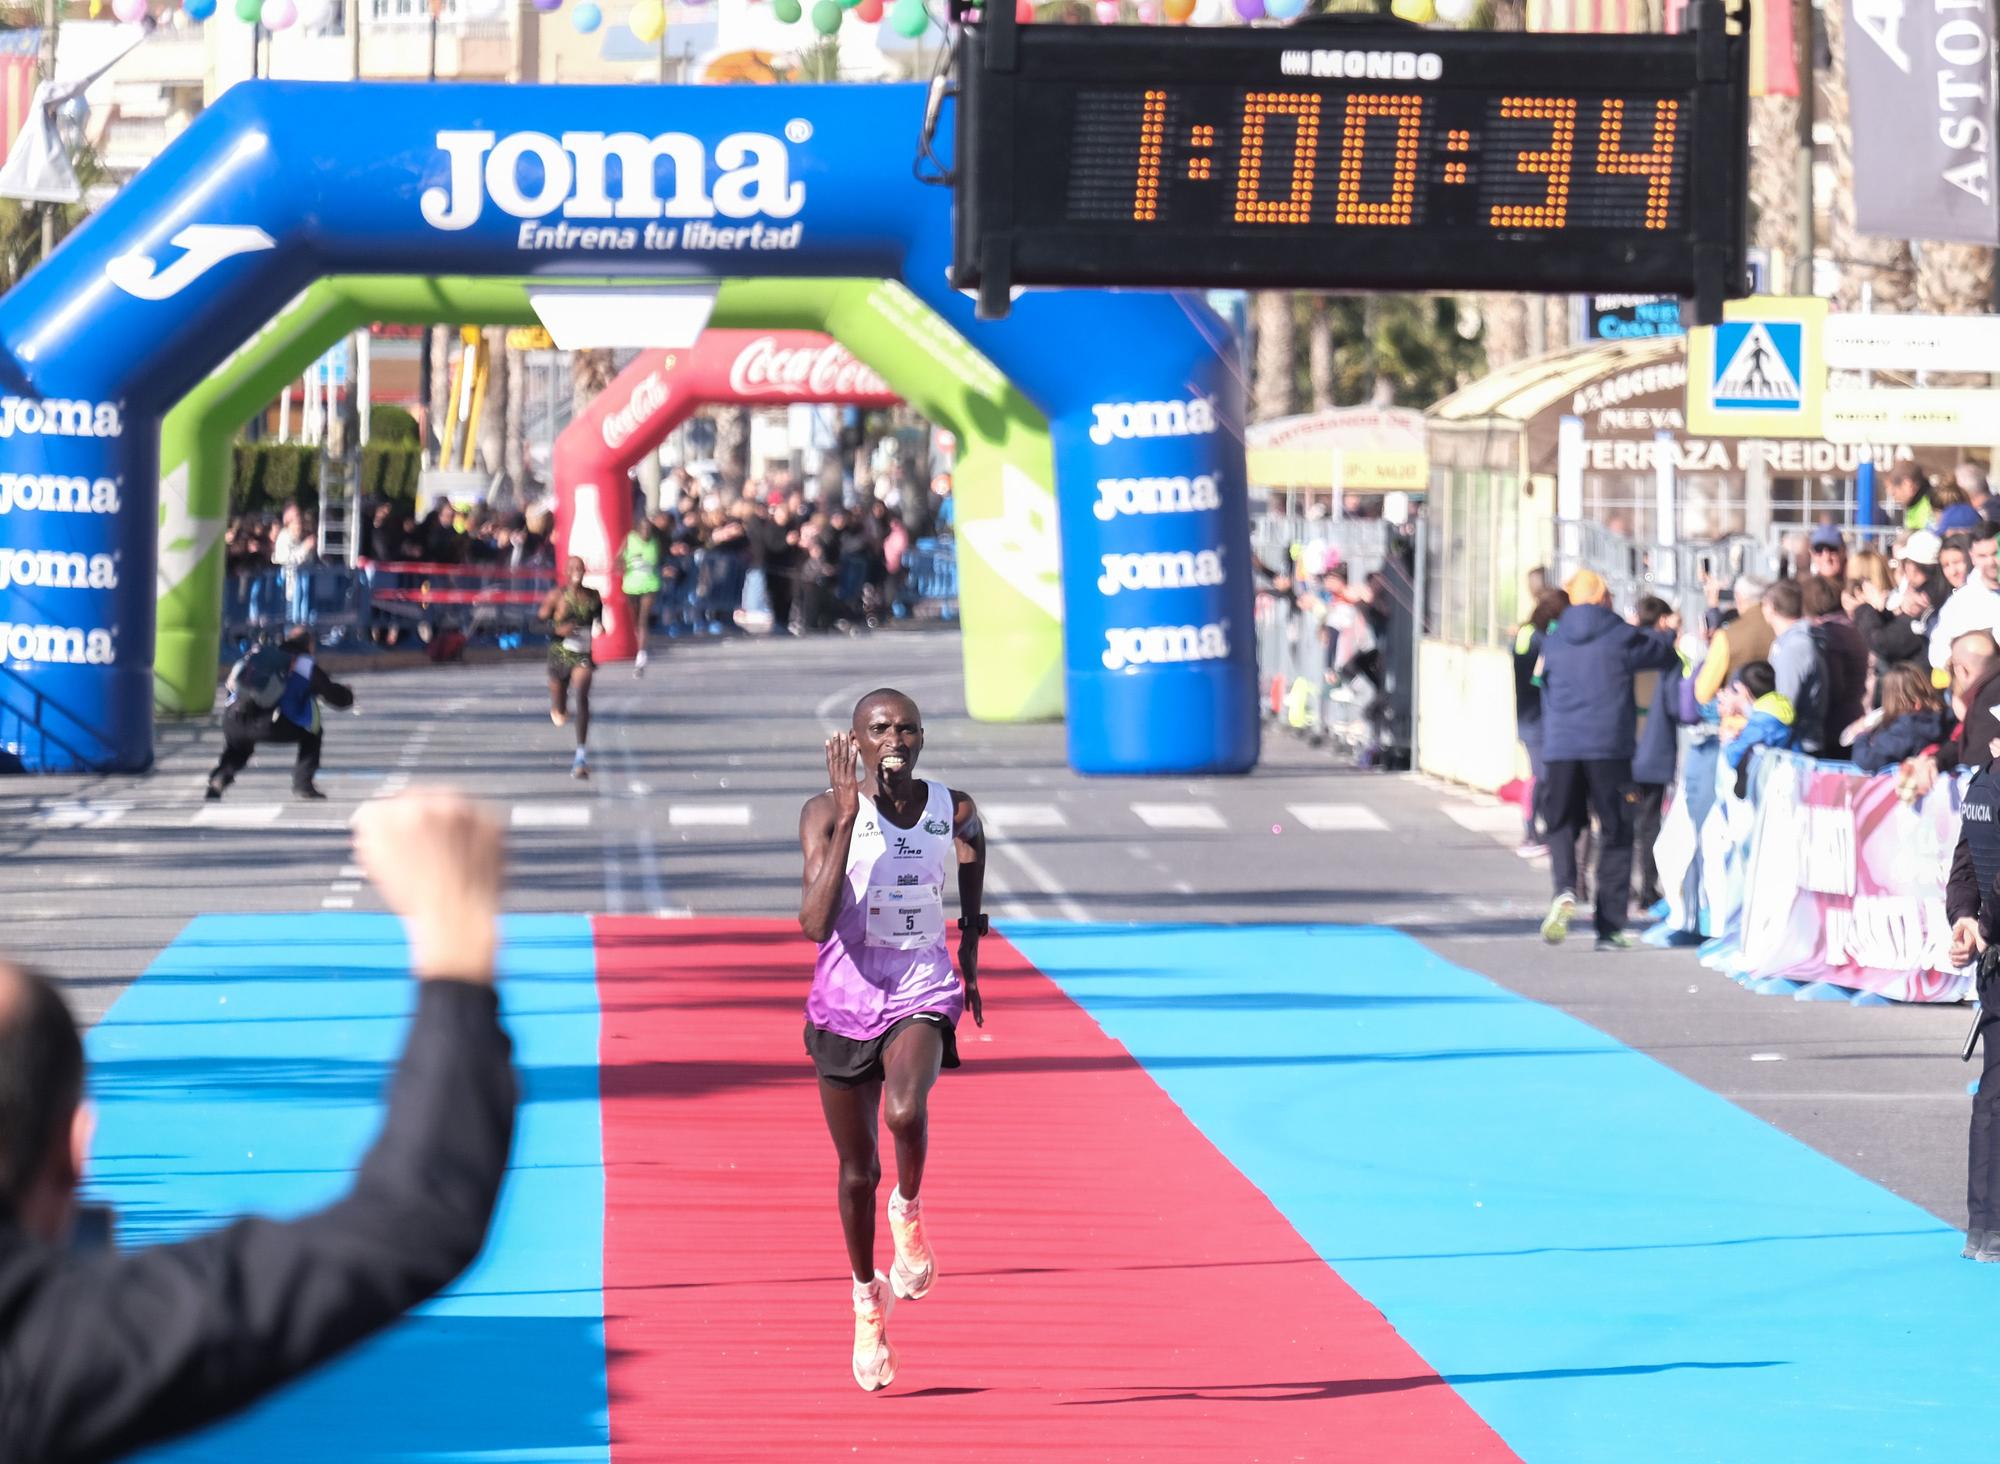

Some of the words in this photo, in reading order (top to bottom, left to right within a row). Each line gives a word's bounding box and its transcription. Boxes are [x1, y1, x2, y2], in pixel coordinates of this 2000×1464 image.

[1311, 49, 1443, 81] MONDO
[1133, 90, 1678, 230] 1:00:34
[517, 220, 637, 249] Entrena
[644, 221, 677, 249] tu
[682, 220, 804, 250] libertad
[906, 915, 915, 931] 5
